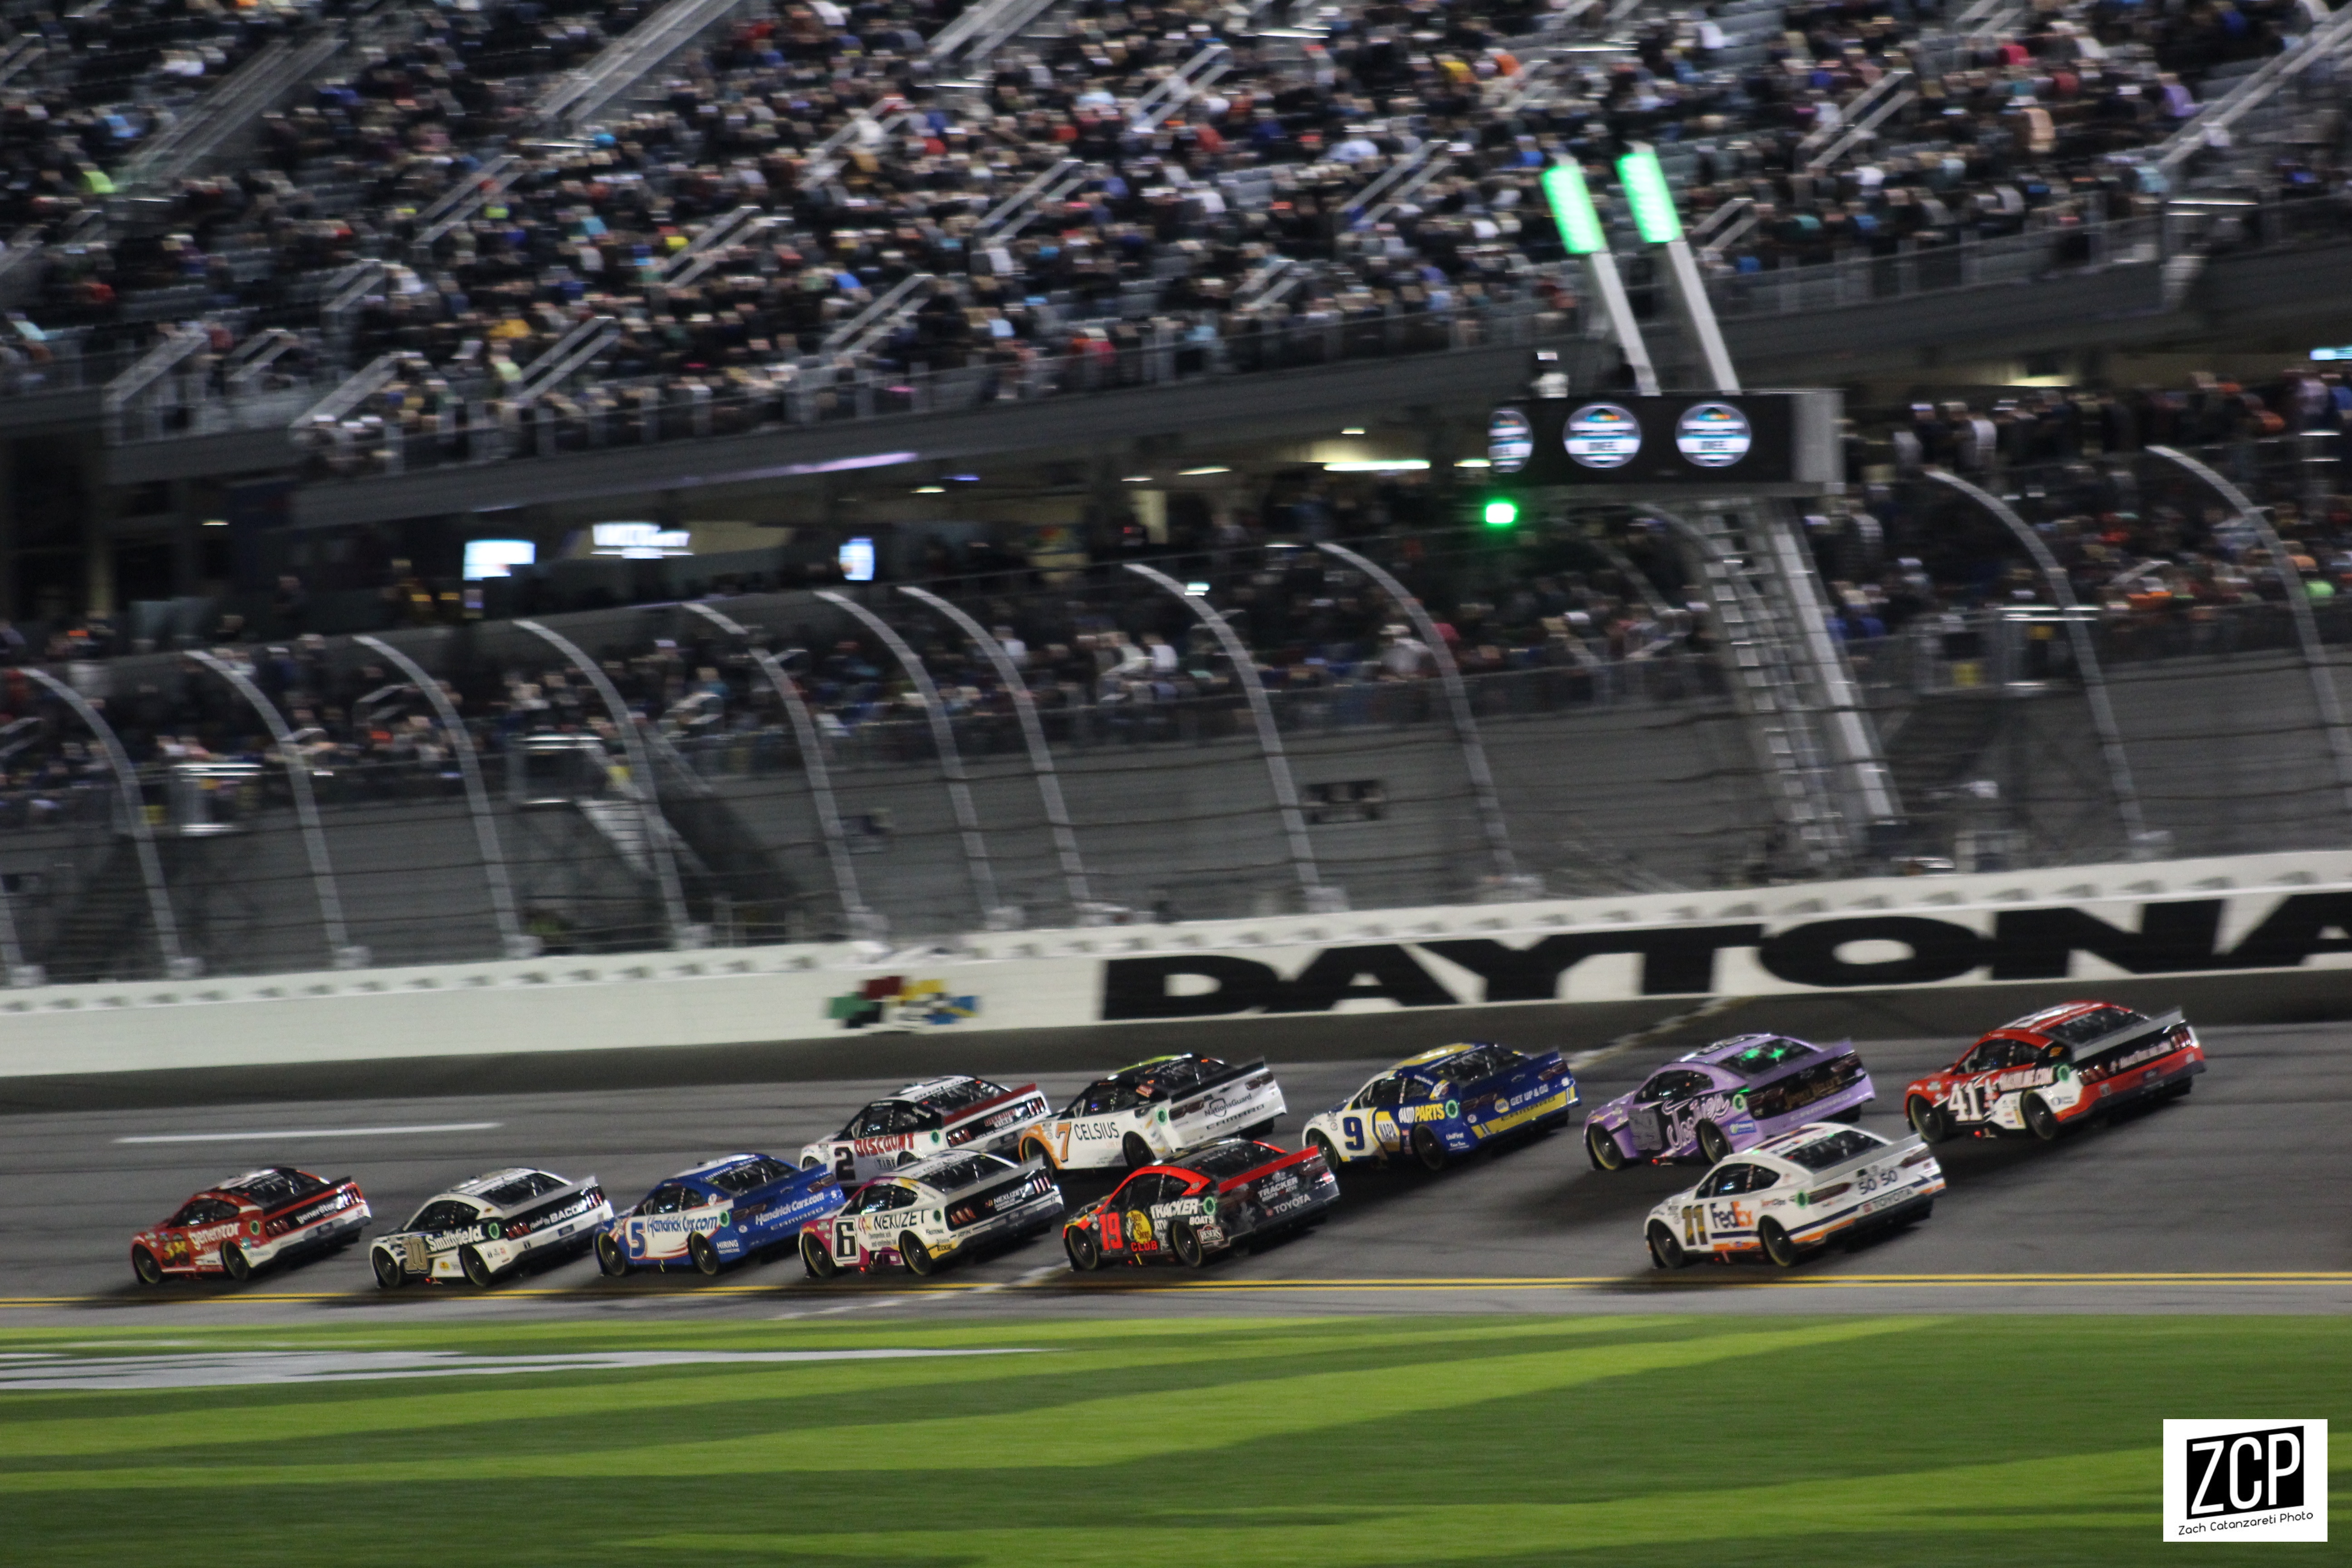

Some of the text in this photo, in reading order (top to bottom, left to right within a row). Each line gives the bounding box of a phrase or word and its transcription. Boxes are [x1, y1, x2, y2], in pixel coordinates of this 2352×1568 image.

[1101, 891, 2352, 1021] DAYTONA
[1205, 1093, 1252, 1117] NationsGuard
[1414, 1103, 1446, 1123] PARTS
[1948, 1082, 1983, 1122] 41
[1055, 1122, 1071, 1163] 7
[1074, 1122, 1119, 1141] CELSIUS
[1343, 1117, 1365, 1151] 9
[1378, 1122, 1396, 1140] NAPA
[854, 1133, 914, 1157] DISCOUNT
[834, 1147, 856, 1181] 2
[994, 1188, 1024, 1204] NEXLIZET
[1258, 1176, 1298, 1198] TRACKER
[1150, 1198, 1199, 1219] TRACKER
[1273, 1194, 1312, 1214] TOYOTA
[1710, 1201, 1754, 1228] FedEx
[1099, 1212, 1123, 1250] 19
[1189, 1215, 1215, 1225] BOATS
[1682, 1205, 1708, 1246] 11
[630, 1222, 646, 1257] 5
[716, 1240, 739, 1249] HIRING
[836, 1221, 857, 1257] 6
[1130, 1240, 1158, 1252] CLUB
[403, 1236, 429, 1273] 10
